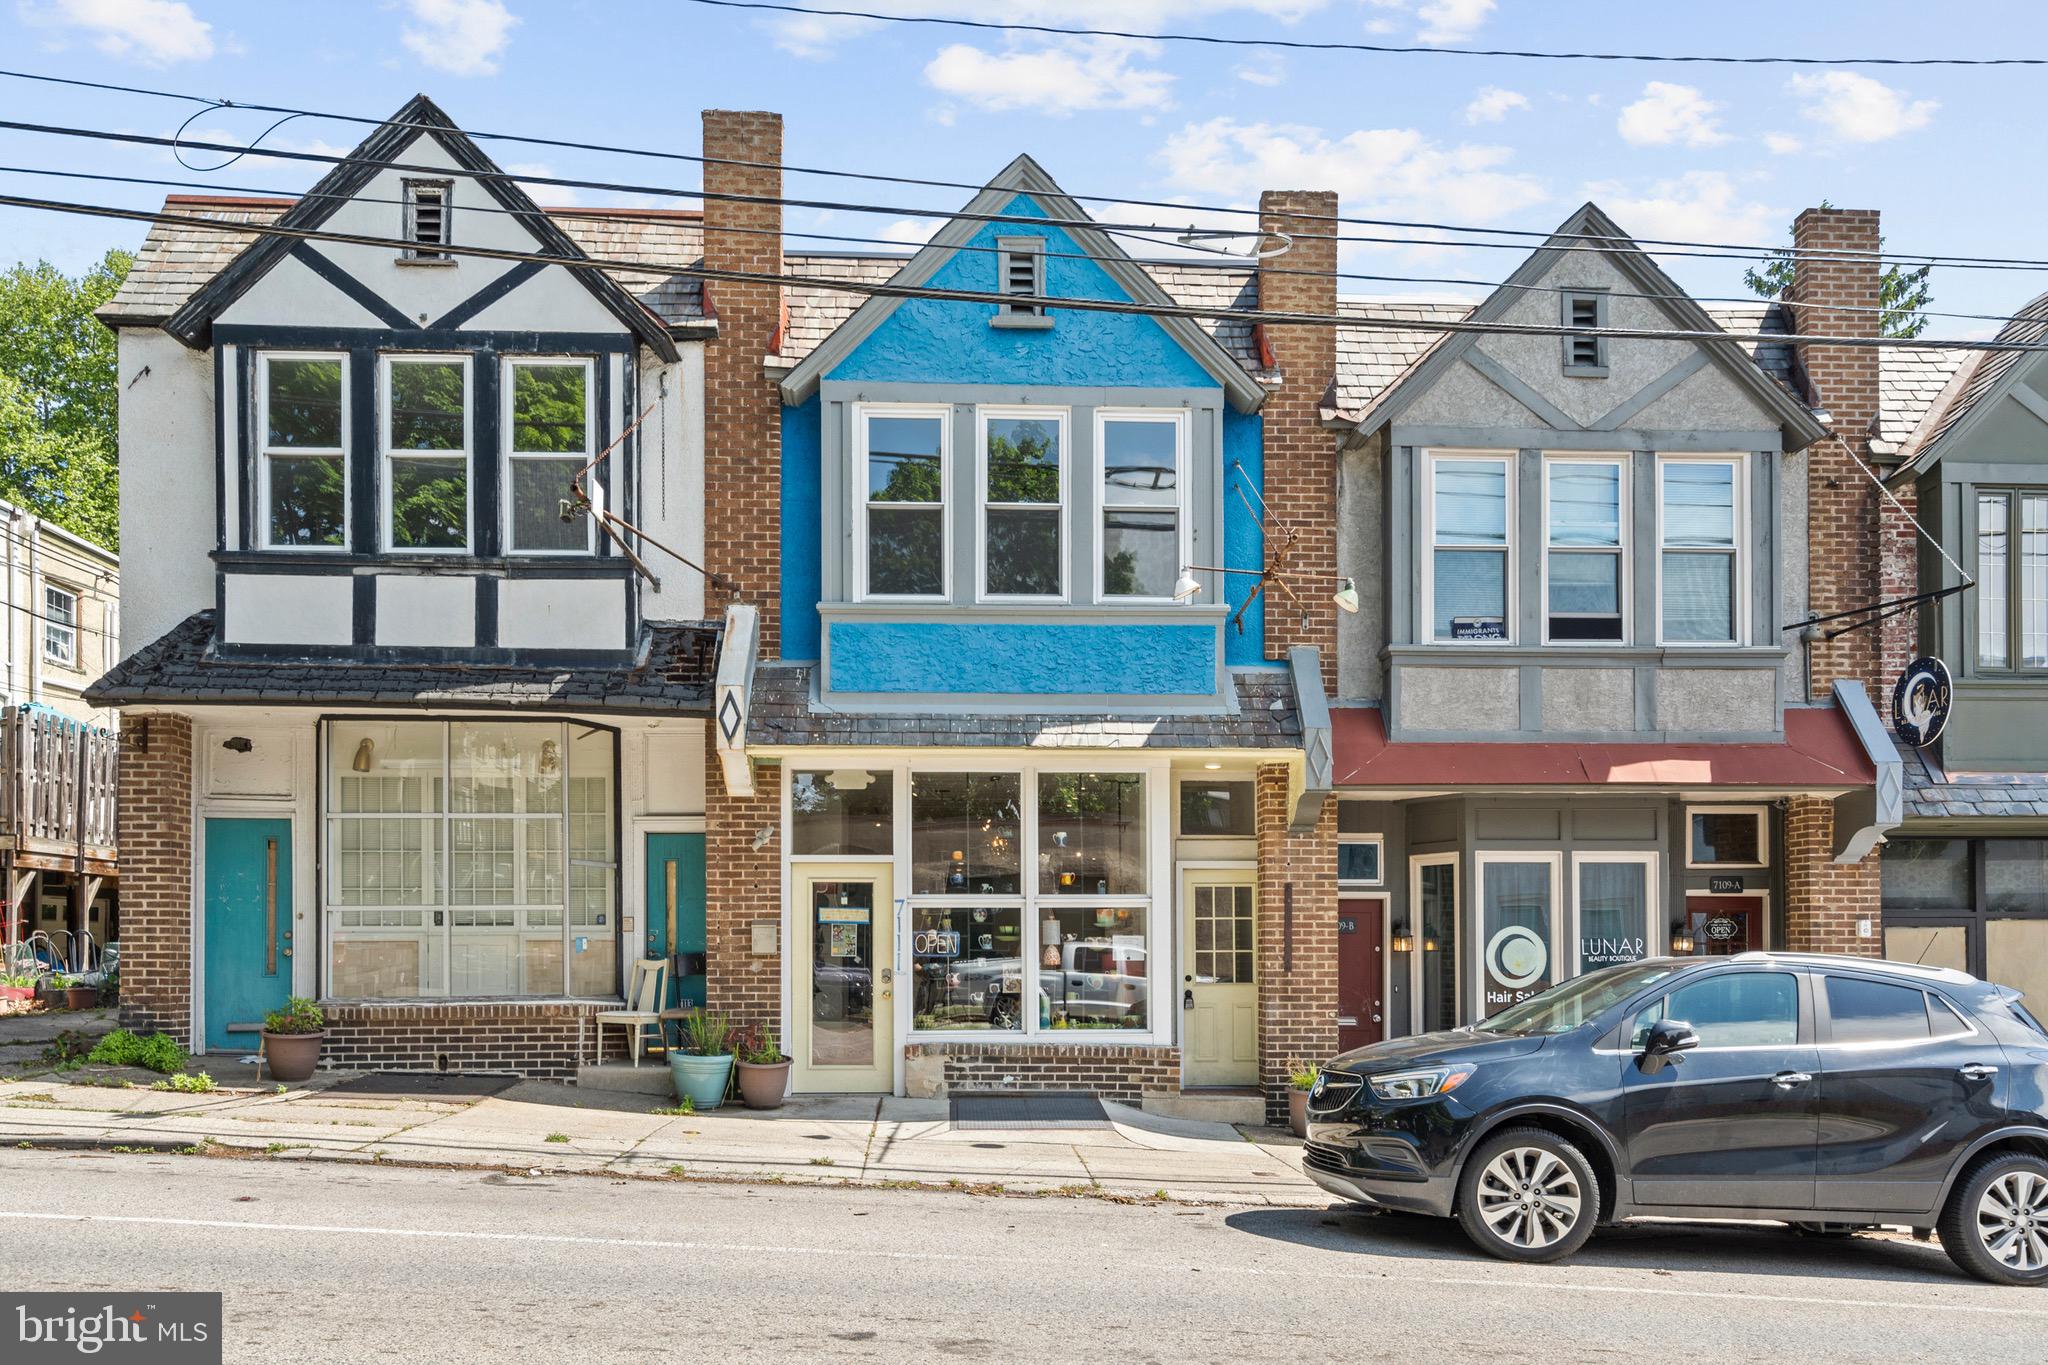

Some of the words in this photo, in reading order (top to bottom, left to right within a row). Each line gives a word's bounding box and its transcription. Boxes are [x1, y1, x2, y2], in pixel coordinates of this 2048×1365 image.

[1456, 627, 1500, 635] IMMIGRANTS
[1713, 880, 1741, 889] 7109-A
[1711, 926, 1731, 934] OPEN
[915, 934, 957, 953] OPEN
[1581, 937, 1643, 955] LUNAR
[1487, 990, 1513, 1003] Hair
